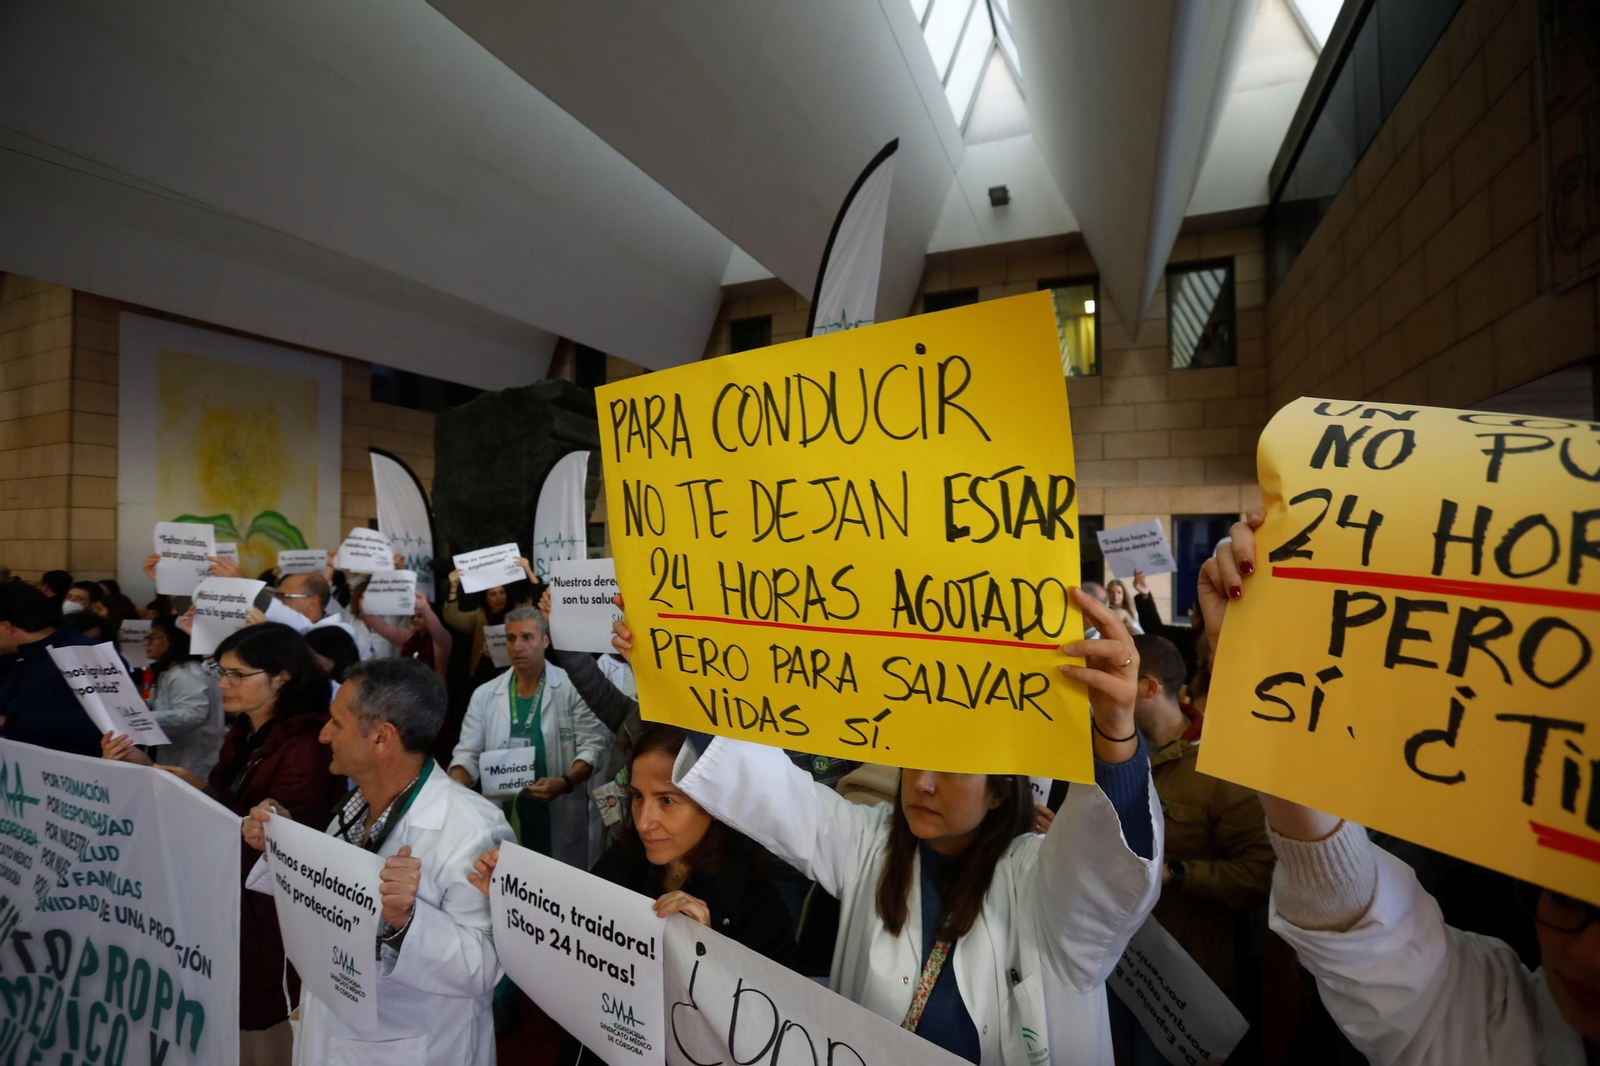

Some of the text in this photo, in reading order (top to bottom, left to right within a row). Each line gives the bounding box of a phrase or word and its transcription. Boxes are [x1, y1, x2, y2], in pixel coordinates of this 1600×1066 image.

[609, 393, 692, 462] PARA
[1313, 402, 1600, 431] UN CO
[1309, 424, 1417, 471] NO
[622, 465, 1077, 543] NO TE DEJAN ESTAR
[1268, 487, 1384, 566] 24
[562, 596, 578, 604] son
[580, 594, 590, 604] tu
[648, 547, 1069, 640] 24 HORAS AGOTADO
[1328, 589, 1592, 690] PERO
[650, 628, 1053, 721] PERO PARA SALVAR
[42, 771, 60, 790] POR
[484, 763, 528, 776] “Mónica
[499, 778, 535, 790] médico
[46, 795, 60, 815] POR
[45, 821, 59, 842] POR
[275, 872, 360, 933] más protección”
[300, 867, 377, 916] explotación,
[115, 906, 145, 933] UNA
[570, 906, 656, 960] traidora!
[507, 908, 635, 986] ¡Stop 24 horas!
[1125, 977, 1134, 987] a
[1133, 969, 1161, 1002] aquí
[600, 1021, 652, 1051] SINDICATO MÉDICO
[607, 1034, 615, 1044] DE
[1136, 988, 1176, 1045] España
[1162, 1003, 1211, 1061] porque
